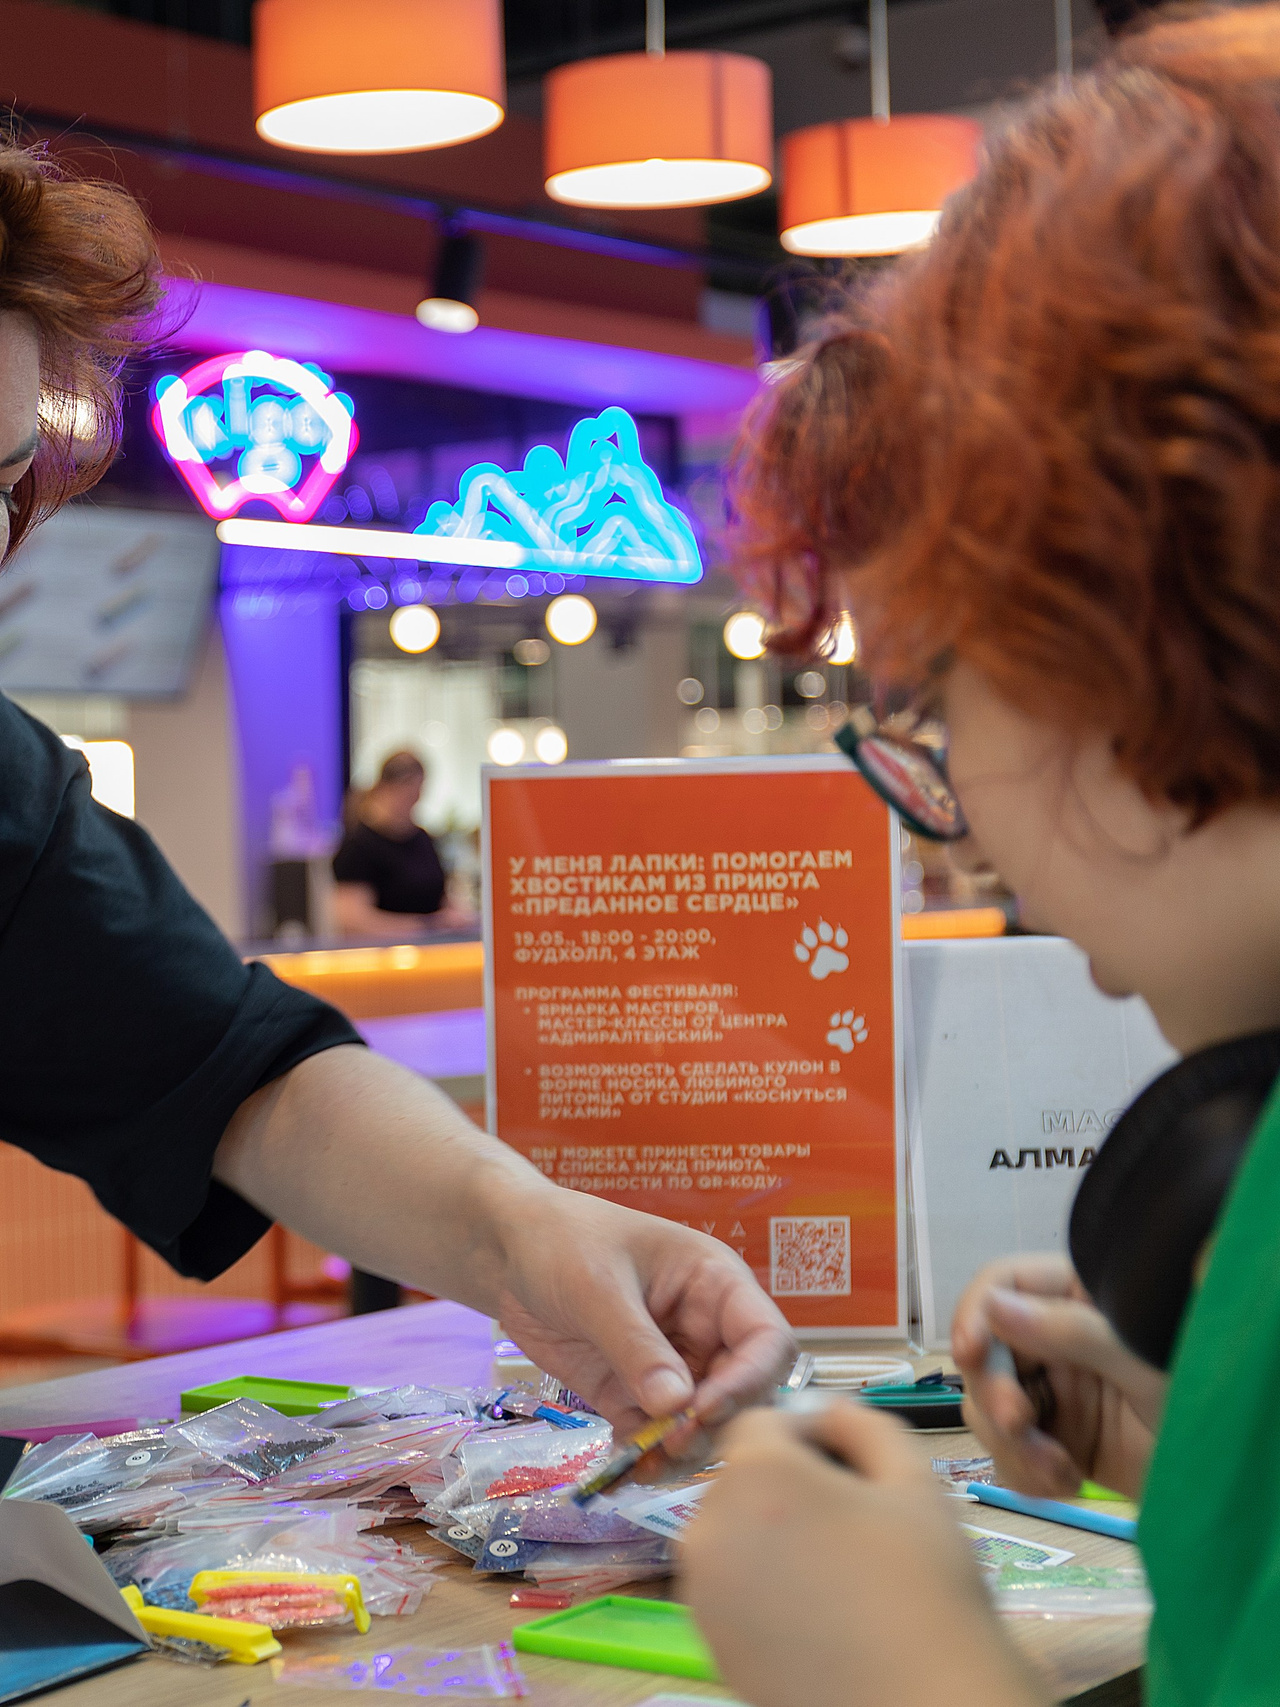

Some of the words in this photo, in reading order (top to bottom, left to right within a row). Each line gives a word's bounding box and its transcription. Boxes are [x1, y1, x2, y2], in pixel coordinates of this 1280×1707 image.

[510, 856, 526, 875] У
[533, 855, 603, 875] МЕНЯ
[609, 853, 705, 873] ЛАПКИ:
[712, 850, 853, 870] ПОМОГАЕМ
[510, 874, 667, 896] ХВОСТИКАМ
[674, 873, 706, 892] ИЗ
[713, 871, 821, 891] ПРИЮТА
[510, 894, 679, 918] «ПРЕДАННОЕ
[686, 892, 800, 915] СЕРДЦЕ»
[582, 929, 634, 945] 18:00
[654, 927, 717, 946] 20:00,
[514, 946, 618, 965] ФУДХОЛЛ,
[624, 946, 637, 961] 4
[642, 944, 700, 961] ЭТАЖ
[515, 985, 622, 1000] ПРОГРАММА
[626, 984, 738, 1000] ФЕСТИВАЛЯ:
[538, 1002, 620, 1016] ЯРМАРКА
[538, 1016, 686, 1030] МАСТЕР-КЛАССЫ
[692, 1015, 715, 1029] ОТ
[721, 1013, 788, 1030] ЦЕНТРА
[539, 1062, 676, 1078] ВОЗМОЖНОСТЬ
[680, 1061, 760, 1077] СДЕЛАТЬ
[764, 1060, 824, 1075] КУЛОН
[829, 1060, 841, 1074] В
[539, 1078, 601, 1092] ФОРМЕ
[607, 1077, 680, 1091] НОСИКА
[685, 1075, 787, 1090] ЛЮБИМОГО
[539, 1092, 625, 1107] ПИТОМЦА
[629, 1091, 653, 1105] ОТ
[657, 1090, 728, 1106] СТУДИИ
[734, 1087, 847, 1103] «КОСНУТЬСЯ
[539, 1106, 622, 1120] РУКАМИ»
[530, 1147, 557, 1159] ВЫ
[561, 1146, 637, 1159] МОЖЕТЕ
[641, 1144, 733, 1159] ПРИНЕСТИ
[739, 1143, 810, 1158] ТОВАРЫ
[989, 1147, 1101, 1170] АЛМА
[558, 1160, 630, 1174] СПИСКА
[634, 1159, 688, 1174] НУЖД
[556, 1176, 663, 1191] ДРОБНОСТИ
[668, 1175, 693, 1189] ПО
